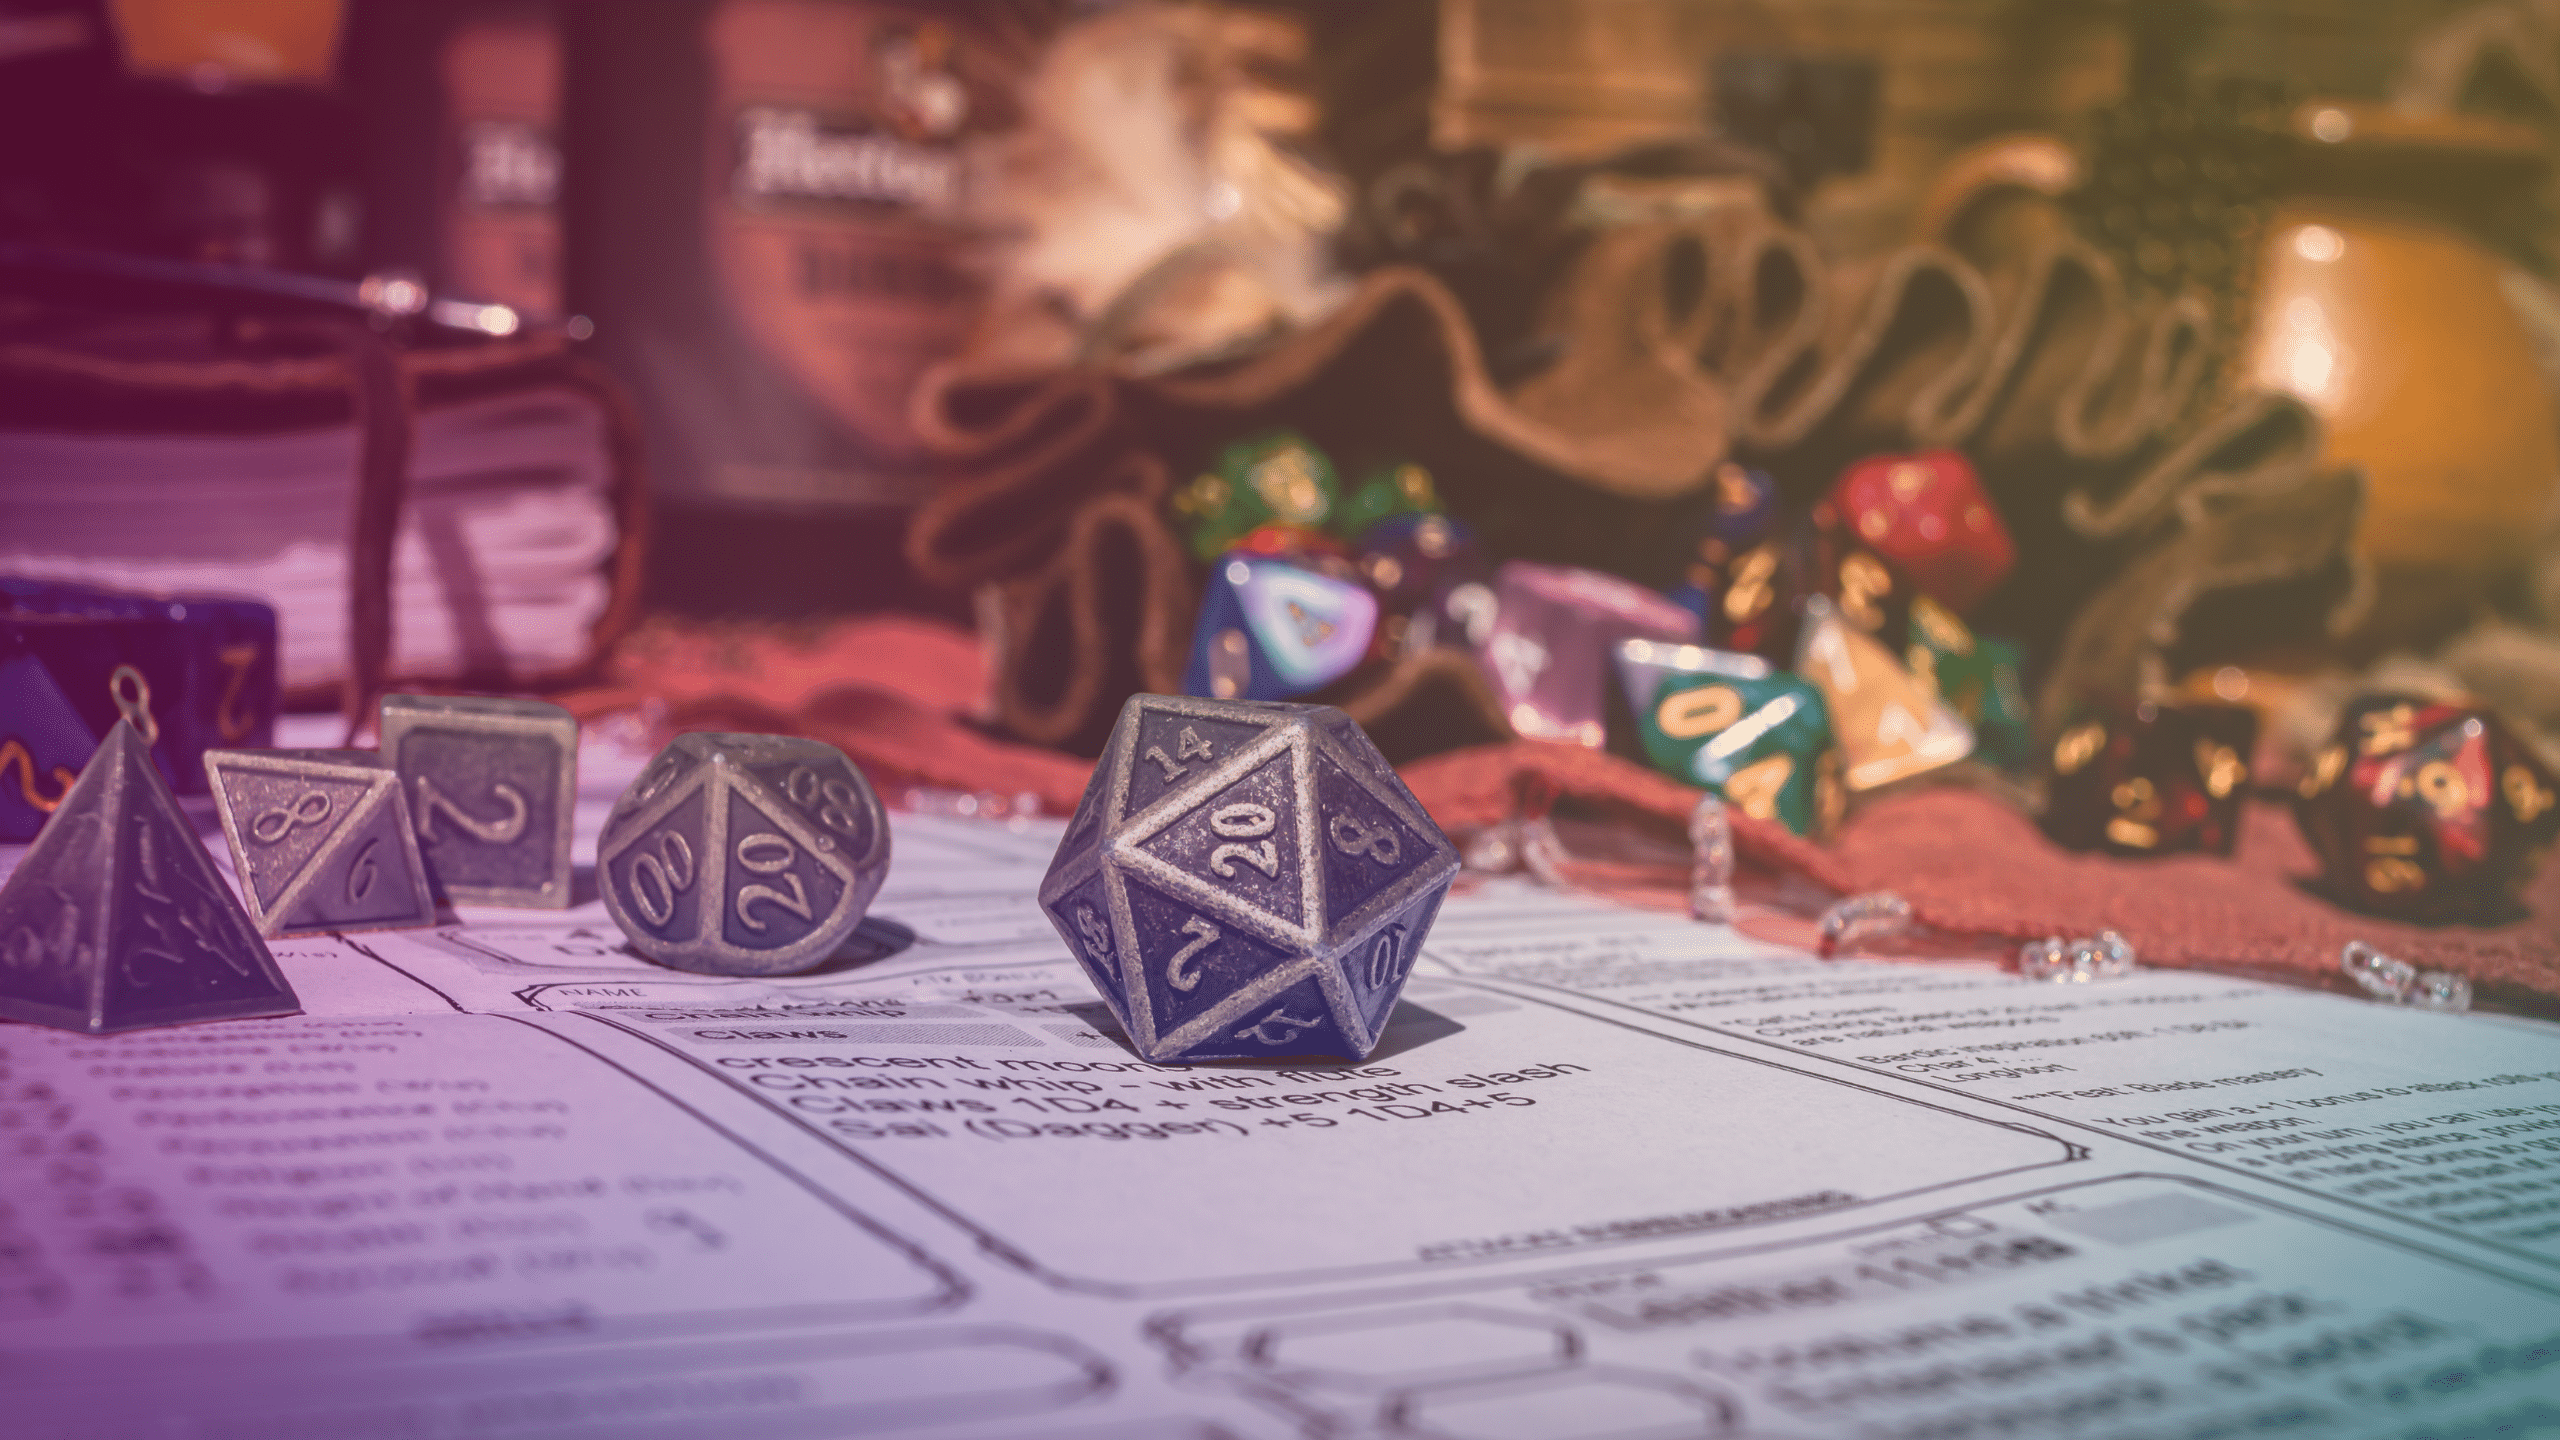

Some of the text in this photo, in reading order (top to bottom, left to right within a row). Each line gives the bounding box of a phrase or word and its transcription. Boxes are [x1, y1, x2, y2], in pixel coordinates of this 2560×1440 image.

[1144, 724, 1214, 784] 14
[252, 790, 332, 842] 8
[417, 774, 528, 845] 2
[1209, 802, 1280, 881] 20
[1330, 811, 1400, 865] 8
[629, 829, 693, 927] 00
[736, 833, 813, 930] 20
[1166, 914, 1221, 992] 2
[1368, 922, 1408, 991] 10
[558, 987, 649, 998] NAME
[692, 1028, 849, 1041] Claws
[1855, 1047, 1959, 1064] Bardic
[715, 1055, 992, 1070] crescent
[750, 1073, 949, 1091] Chain
[953, 1075, 1104, 1095] whip
[1148, 1075, 1276, 1092] with
[1275, 1066, 1402, 1084] flute
[788, 1062, 1592, 1114] Claws 1D4 + strength slash
[1896, 1058, 1970, 1074] Char
[2123, 1080, 2217, 1094] Blade
[2213, 1066, 2325, 1086] mastery
[963, 1116, 1250, 1142] (Dagger)
[1259, 1112, 1339, 1129] +5
[1346, 1091, 1537, 1122] 1D4+5
[2091, 1113, 2168, 1128] You
[2164, 1106, 2235, 1123] gain
[2229, 1105, 2257, 1115] a
[2255, 1099, 2298, 1111] +1
[2285, 1091, 2384, 1108] bonus
[2370, 1087, 2413, 1097] to
[2405, 1080, 2493, 1094] attack
[2184, 1140, 2238, 1154] On
[2236, 1133, 2312, 1150] your
[2300, 1126, 2385, 1140] turn,
[2369, 1120, 2435, 1135] you
[2426, 1111, 2476, 1126] can
[2475, 1105, 2535, 1119] use
[2138, 1128, 2201, 1142] the
